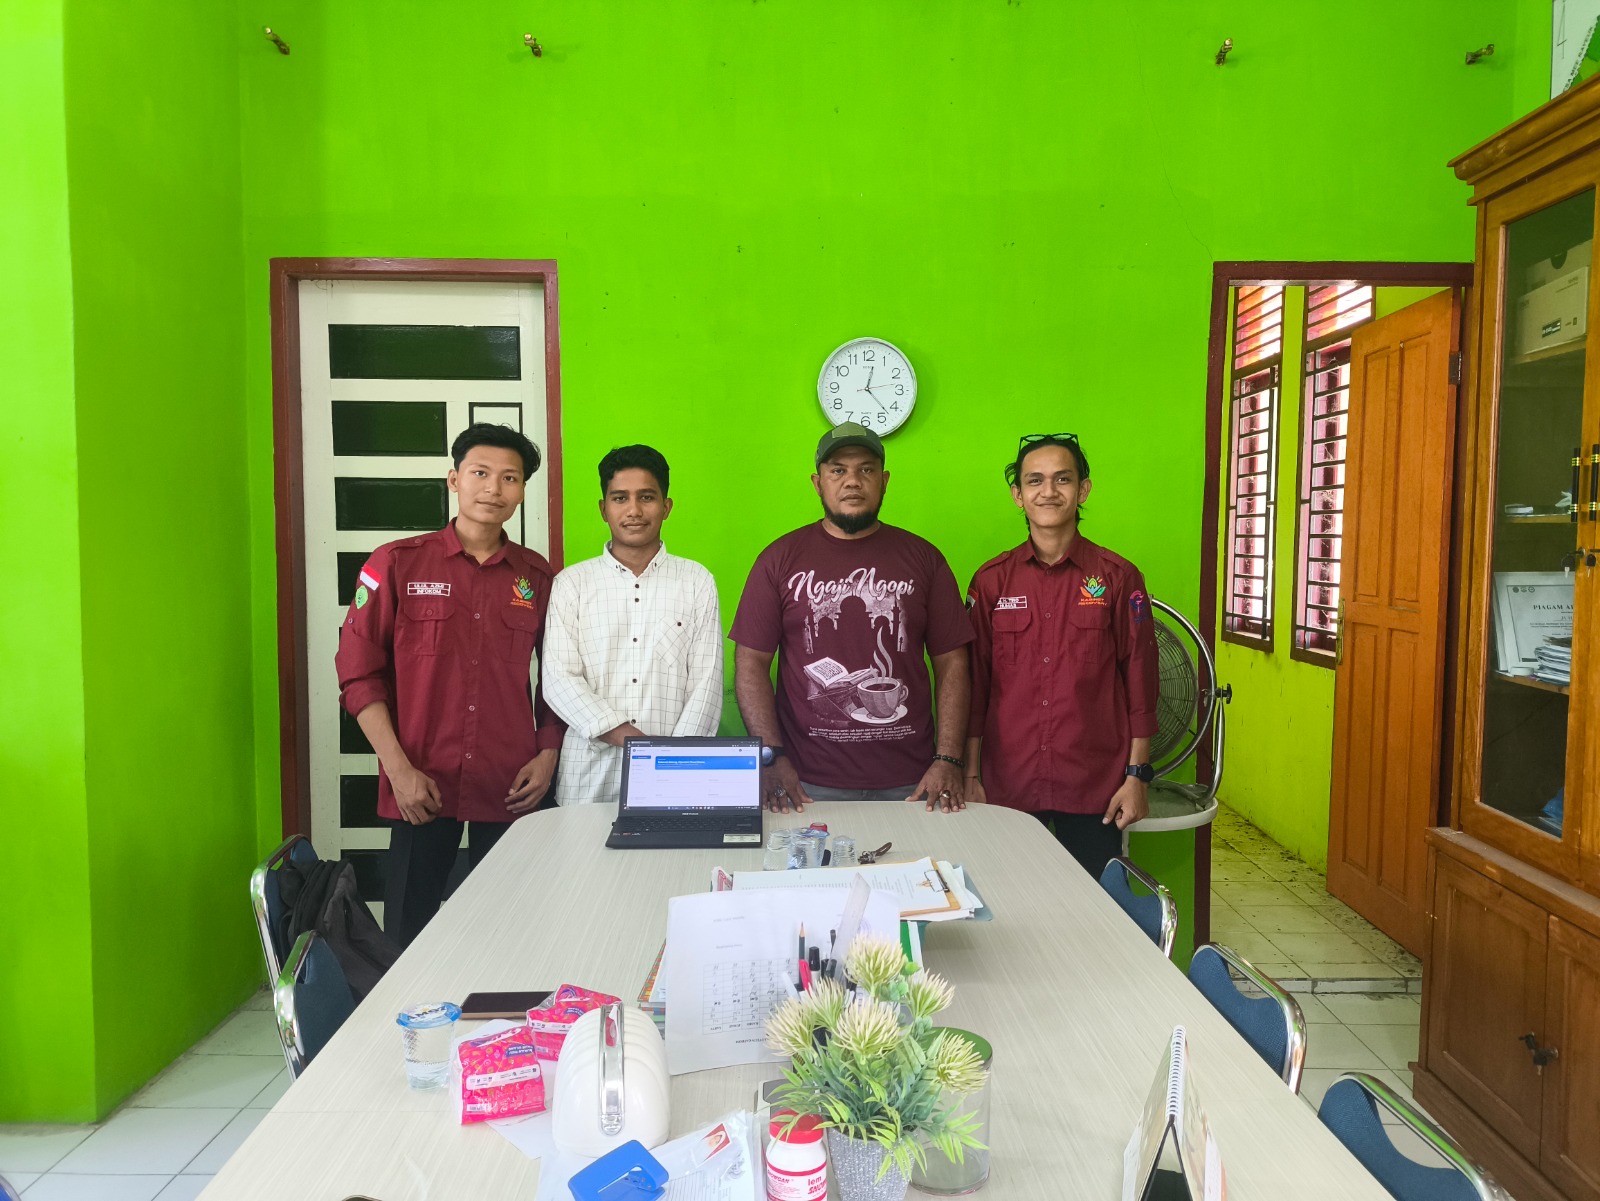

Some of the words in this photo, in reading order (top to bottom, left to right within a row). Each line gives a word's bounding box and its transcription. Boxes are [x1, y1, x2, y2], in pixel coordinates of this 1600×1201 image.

[848, 354, 858, 366] 11
[863, 350, 875, 362] 12
[882, 355, 886, 367] 1
[835, 365, 849, 377] 10
[891, 367, 901, 380] 2
[829, 381, 840, 394] 9
[894, 384, 905, 396] 3
[833, 398, 843, 410] 8
[889, 401, 899, 412] 4
[845, 411, 854, 422] 7
[860, 415, 871, 428] 6
[877, 412, 887, 424] 5
[788, 570, 851, 603] Ngaji
[847, 567, 915, 601] Ngopi
[807, 1176, 822, 1187] lem
